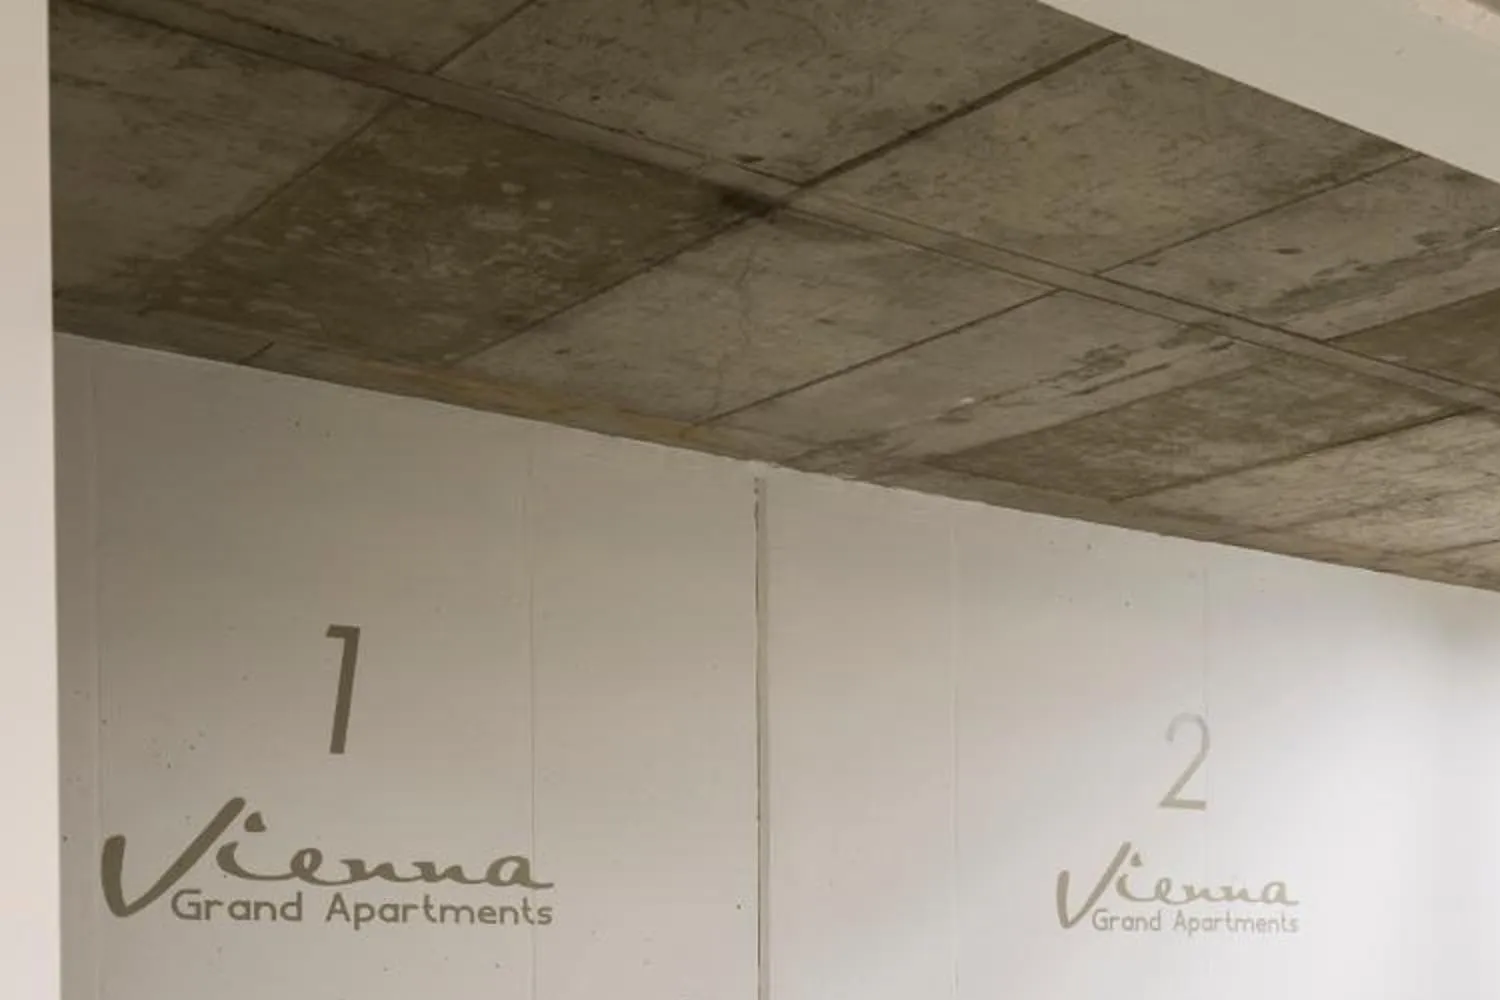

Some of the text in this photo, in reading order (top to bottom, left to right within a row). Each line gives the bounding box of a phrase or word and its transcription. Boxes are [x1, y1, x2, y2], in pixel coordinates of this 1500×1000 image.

[325, 623, 361, 754] 1
[1158, 712, 1210, 811] 2
[101, 797, 554, 918] Vienna
[1056, 841, 1299, 929] Vienna
[171, 889, 553, 930] Grand Apartments
[1092, 908, 1299, 936] Grand Apartments
